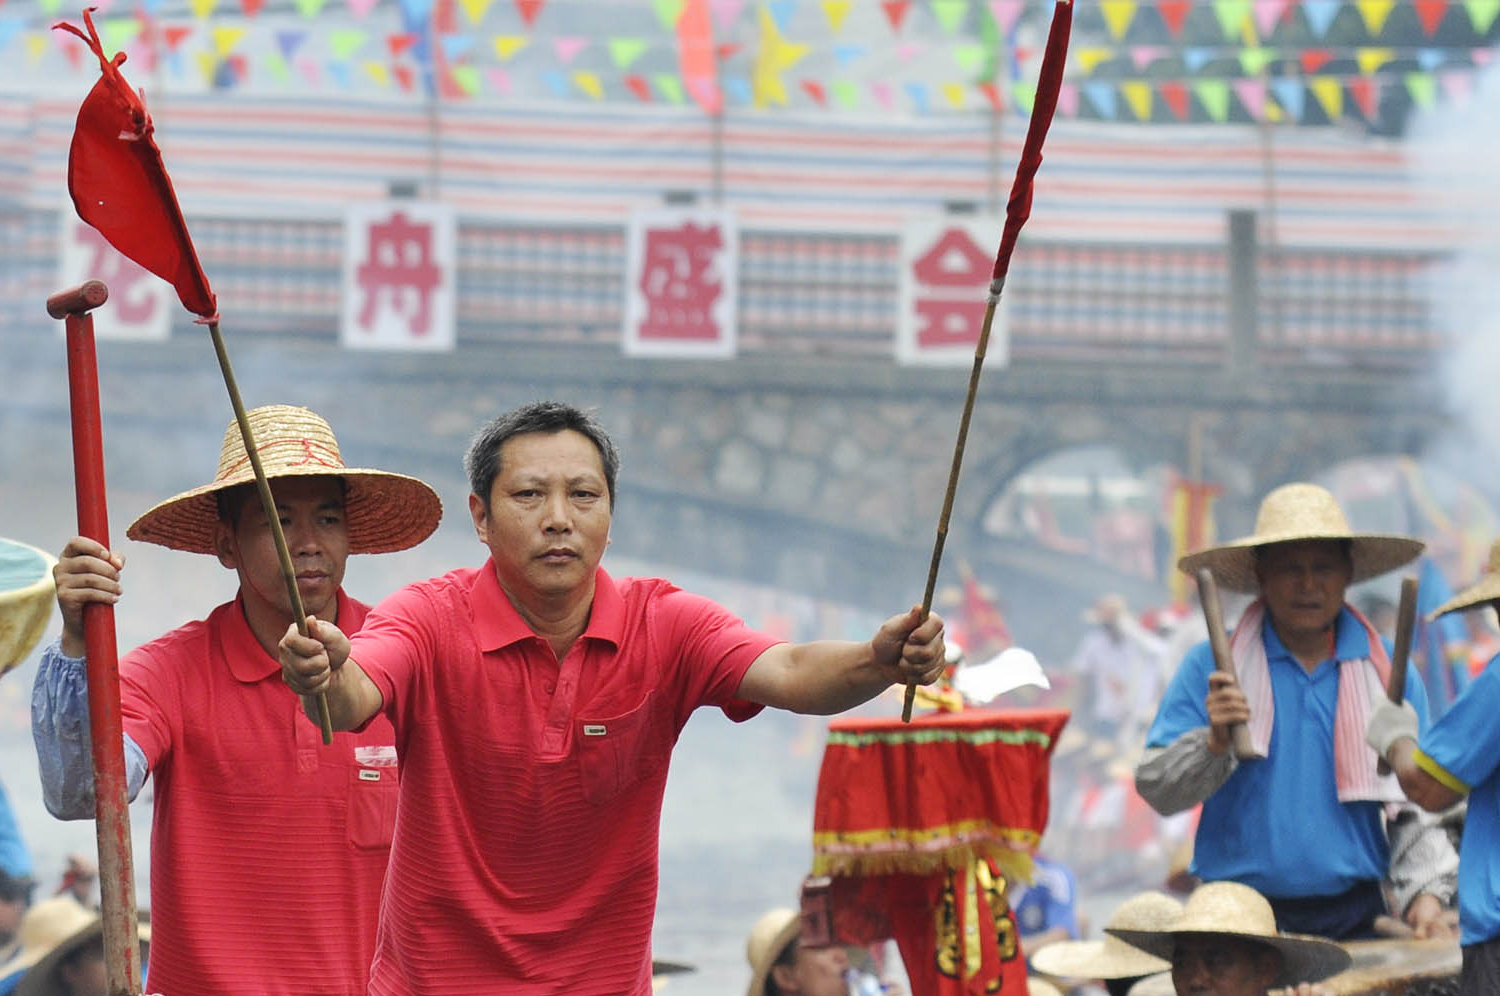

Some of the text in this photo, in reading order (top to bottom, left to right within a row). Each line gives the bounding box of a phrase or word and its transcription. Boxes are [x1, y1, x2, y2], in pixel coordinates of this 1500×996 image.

[356, 211, 442, 336] 舟
[638, 221, 724, 342] 盛
[912, 227, 994, 348] 会
